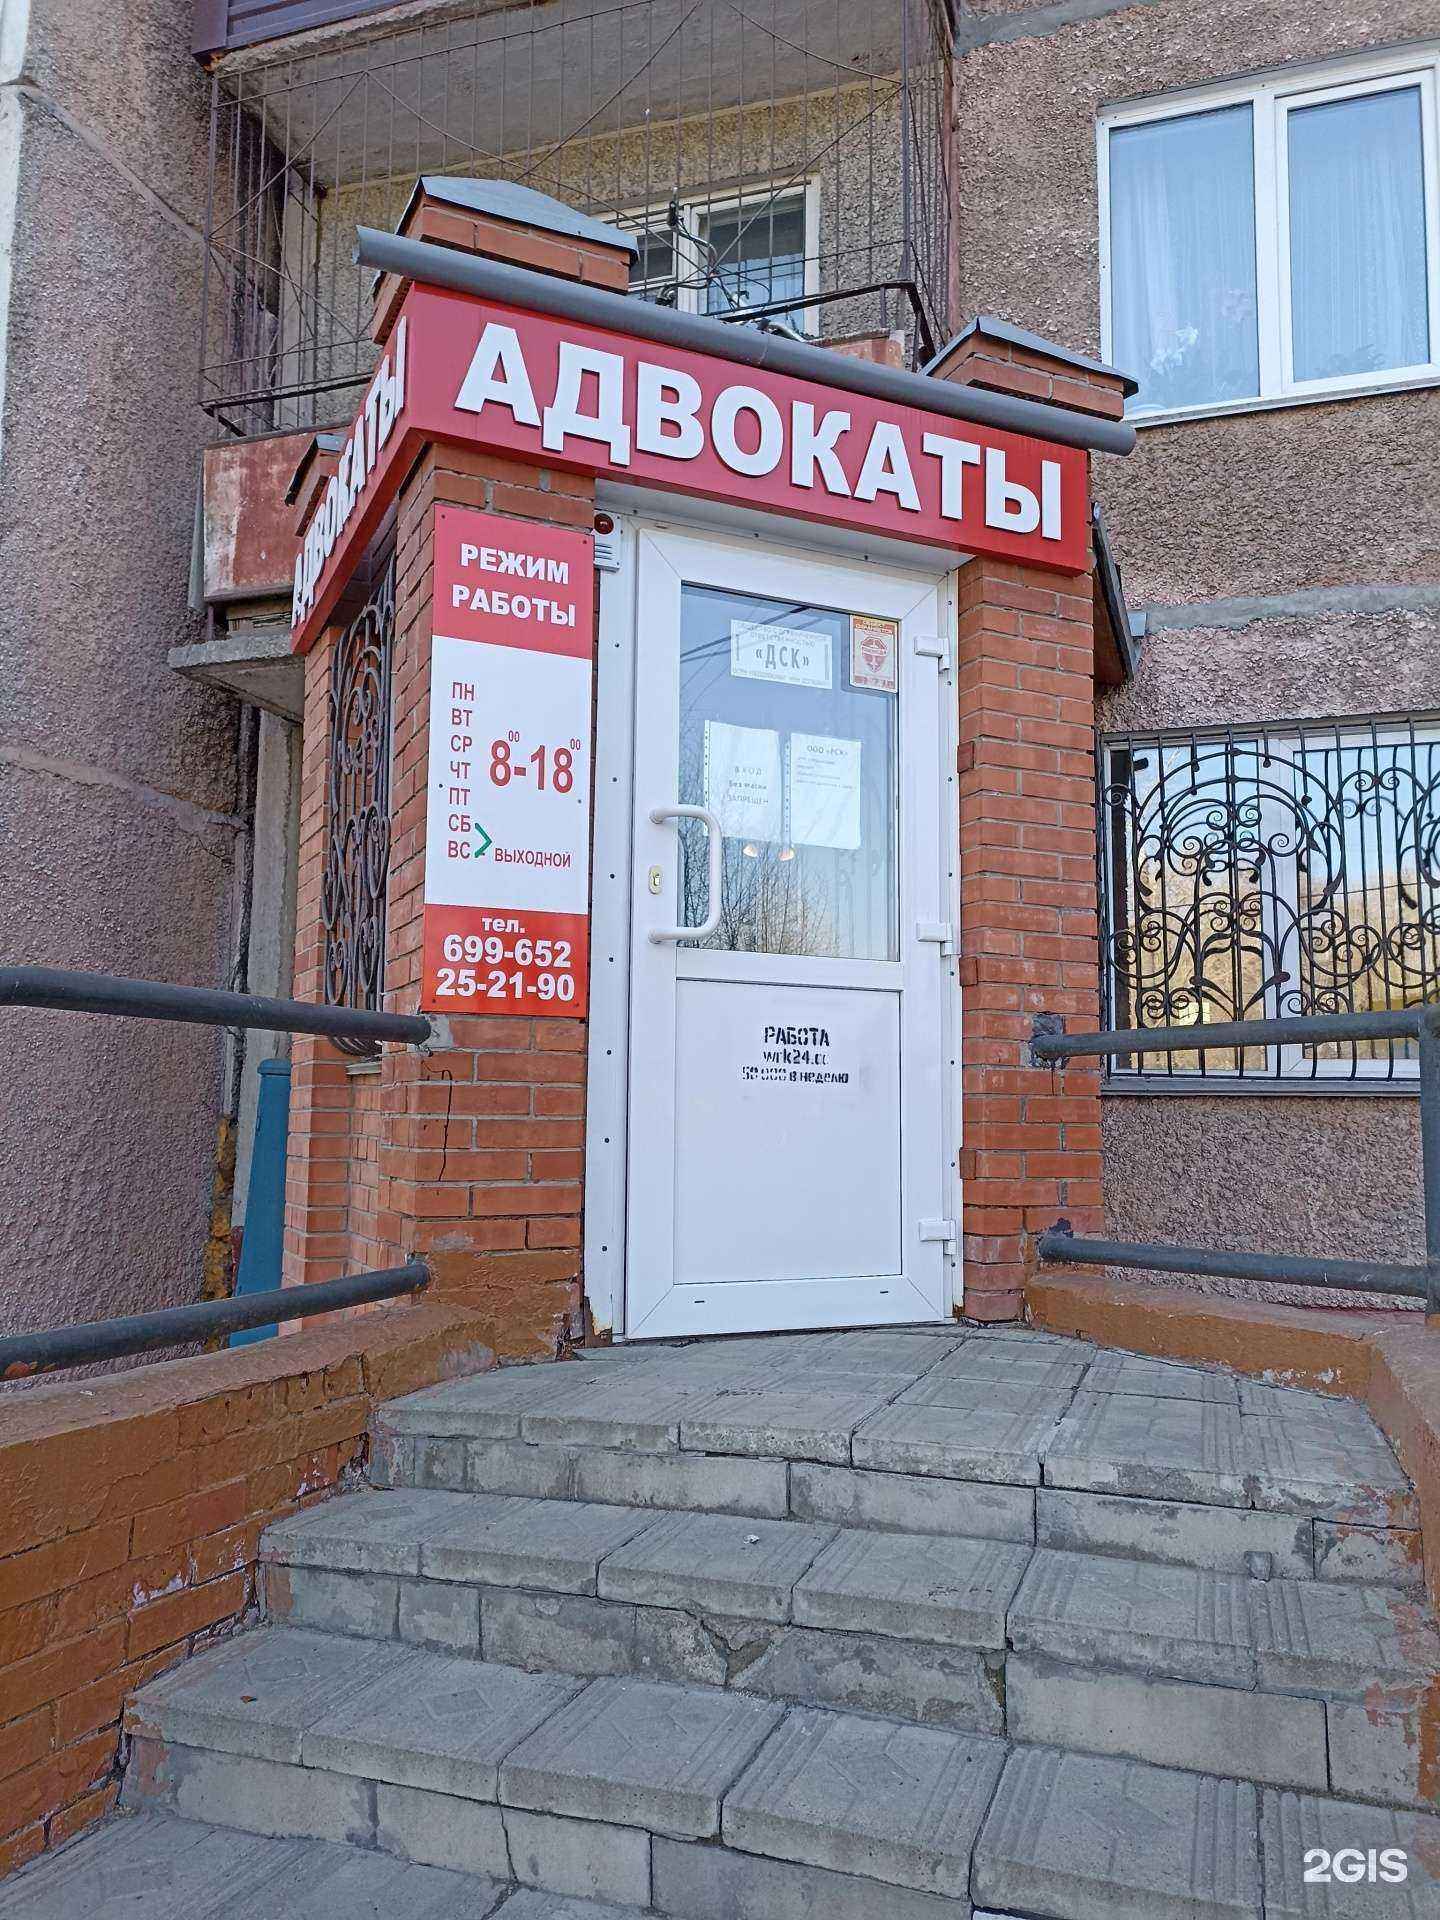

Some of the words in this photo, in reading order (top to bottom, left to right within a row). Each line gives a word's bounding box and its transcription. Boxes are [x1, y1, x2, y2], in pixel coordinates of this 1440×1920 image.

[454, 322, 1063, 541] АДВОКАТЫ
[291, 315, 407, 629] АДВОКАТЫ
[459, 542, 570, 586] РЕЖИМ
[451, 583, 577, 628] РАБОТЫ
[452, 682, 475, 701] ПН
[451, 708, 473, 727] ВТ
[450, 735, 473, 753] СР
[450, 761, 471, 779] ЧТ
[449, 787, 471, 806] ПТ
[448, 814, 471, 833] СБ
[447, 840, 471, 859] ВС
[494, 847, 571, 868] ВЫХОДНОЙ
[481, 916, 526, 934] тел.
[443, 935, 572, 969] 699-652
[435, 966, 575, 1002] 25-21-90
[764, 1026, 830, 1047] РАБОТА
